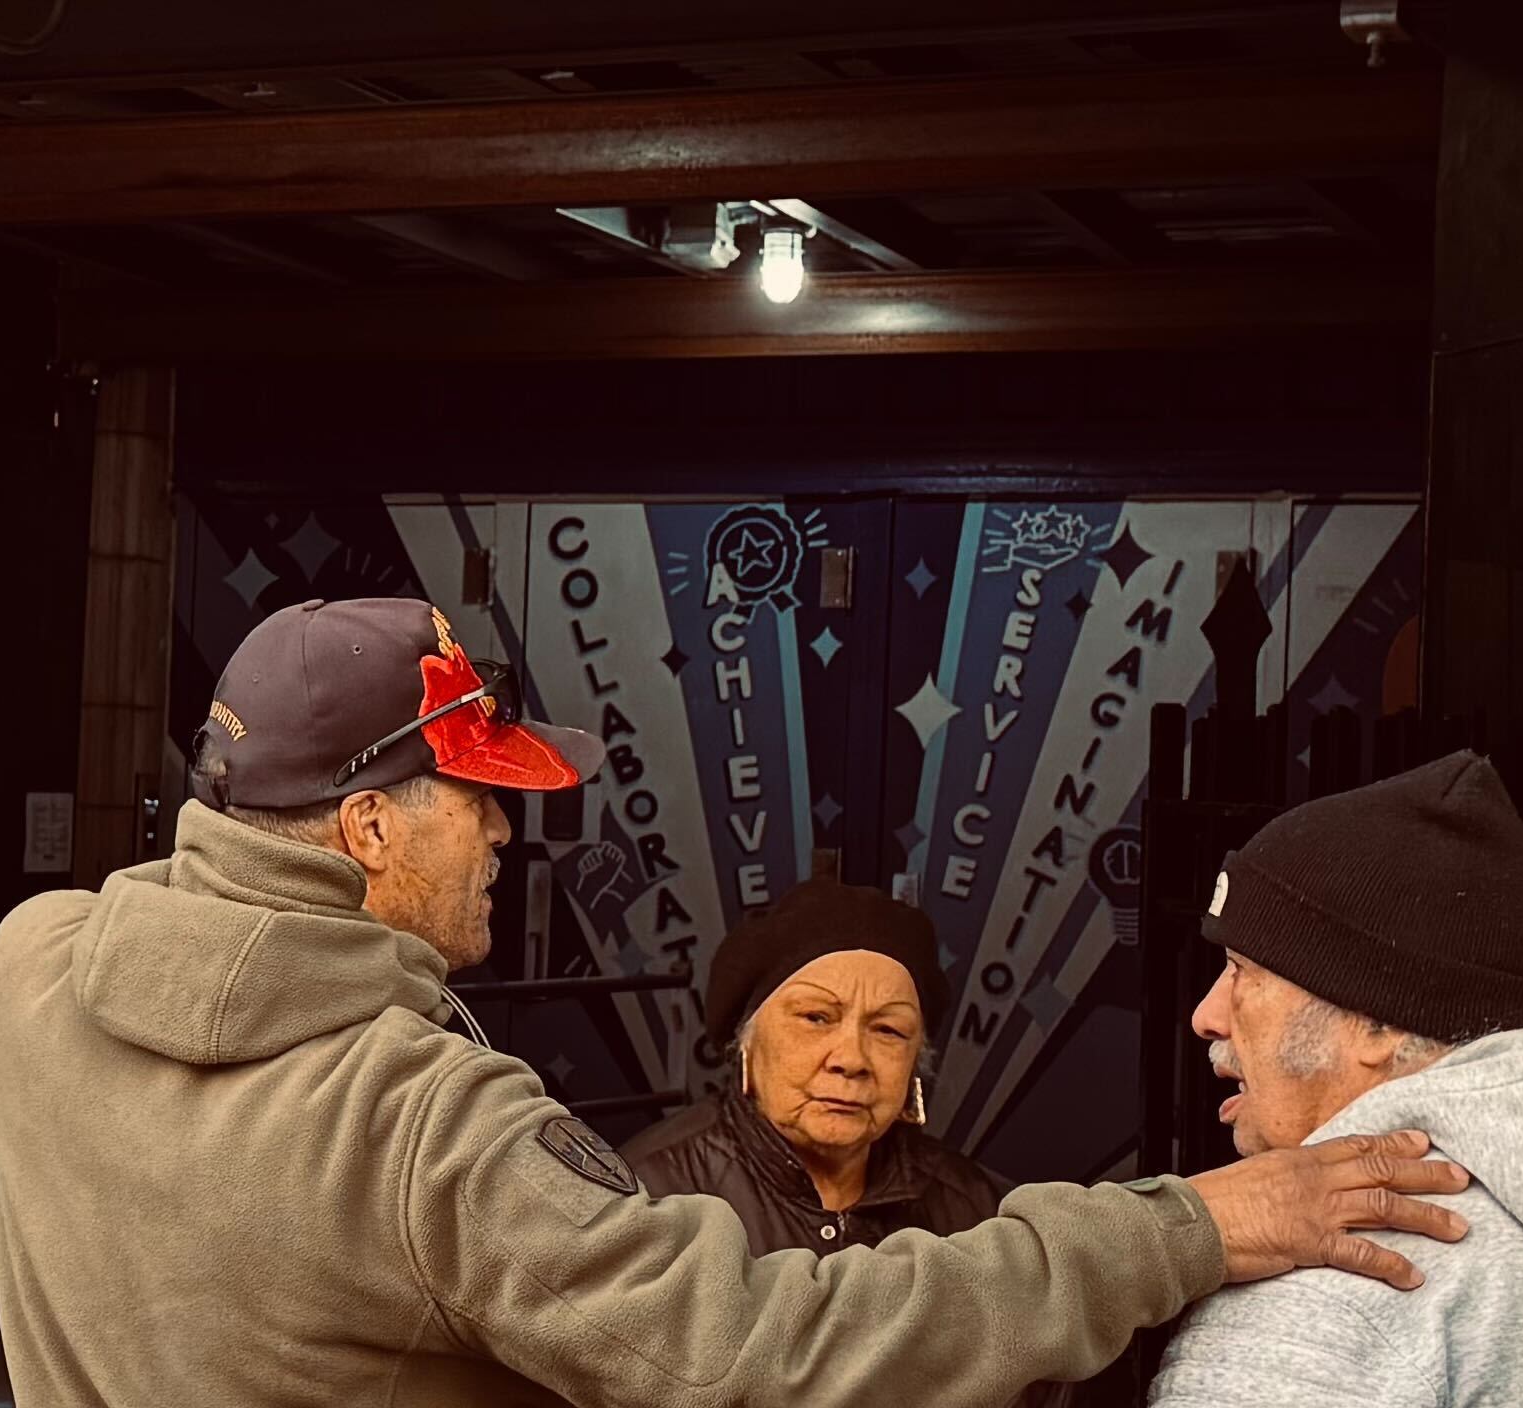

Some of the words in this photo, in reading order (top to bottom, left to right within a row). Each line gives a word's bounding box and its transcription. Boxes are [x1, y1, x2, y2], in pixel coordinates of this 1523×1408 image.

[548, 516, 726, 1080] COLLABORATIO
[704, 563, 770, 907] ACHIEVE
[941, 568, 1043, 897] SERVICE
[958, 558, 1184, 1045] IMAGINATION
